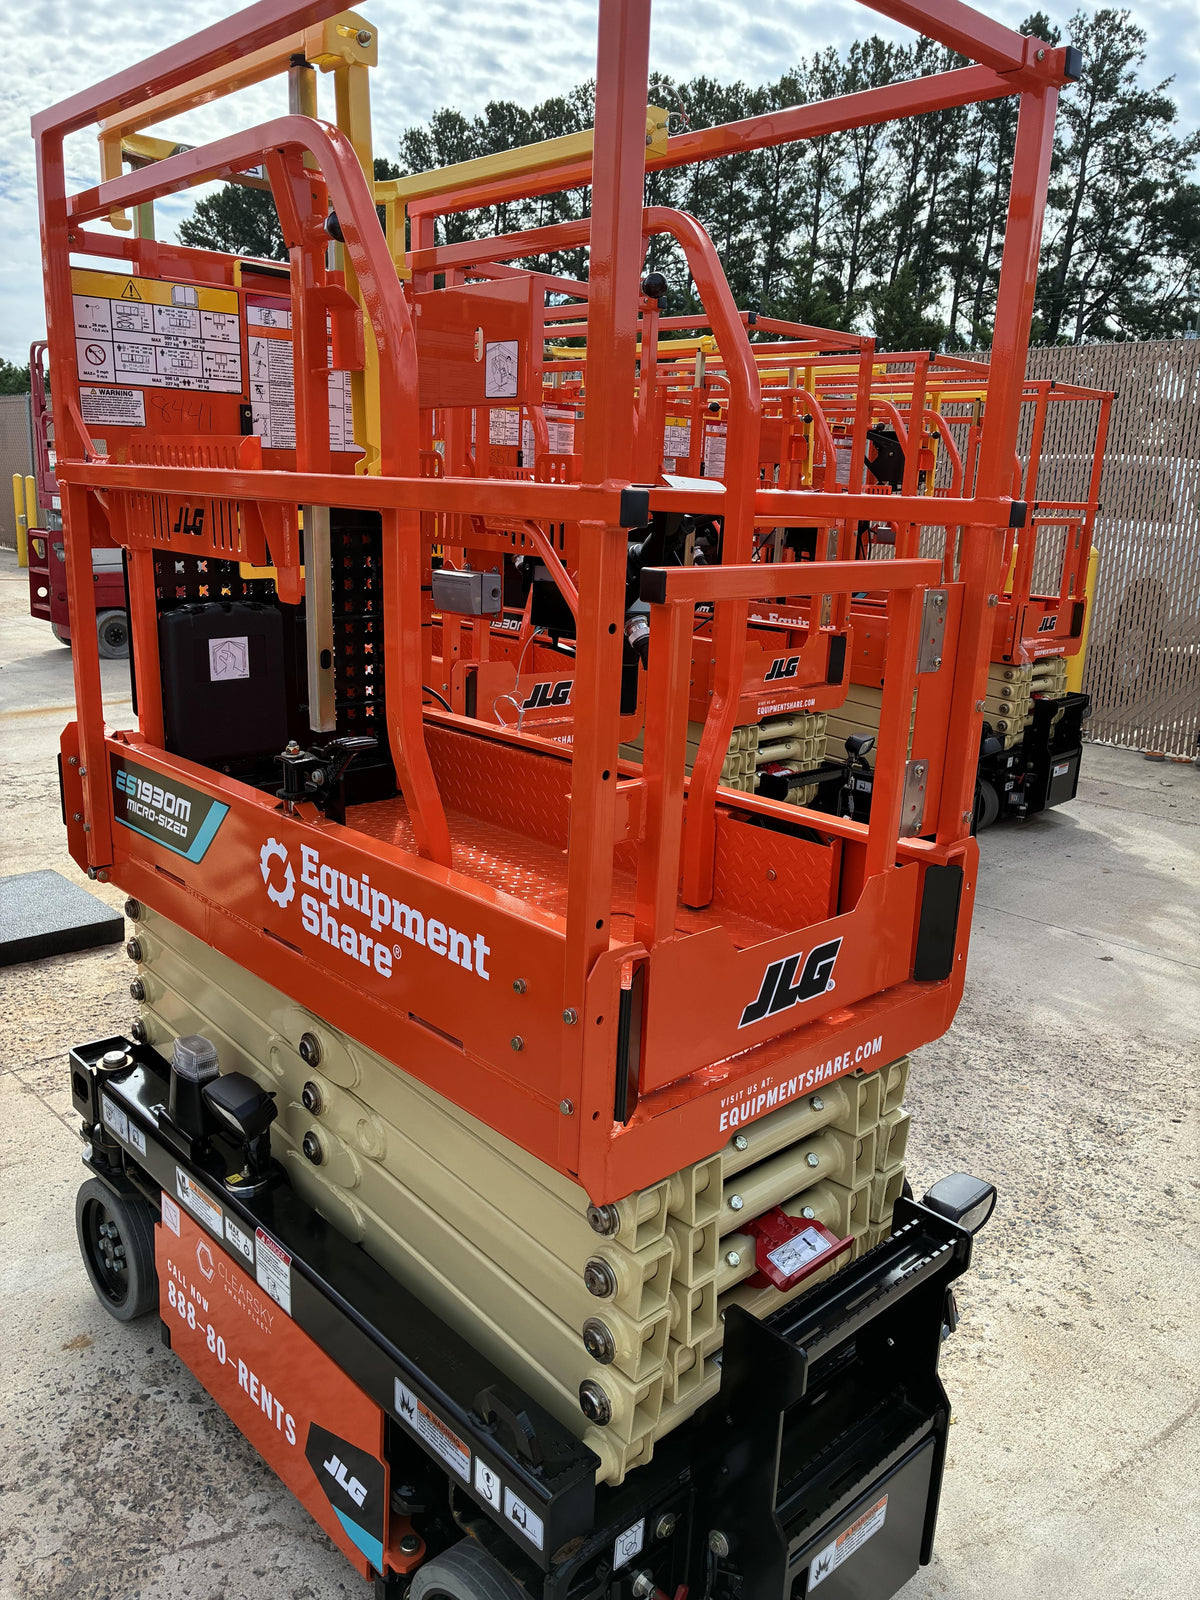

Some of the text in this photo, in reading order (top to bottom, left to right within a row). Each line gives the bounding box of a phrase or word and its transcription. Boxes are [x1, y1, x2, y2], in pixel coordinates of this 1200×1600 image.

[98, 388, 134, 397] WARNING
[151, 395, 212, 433] 8441
[173, 506, 205, 537] JLG
[1037, 615, 1058, 633] JLG
[763, 655, 801, 682] JLG
[522, 680, 574, 709] JLG
[757, 698, 816, 715] EQUIPMENTSHARE.COM
[115, 769, 192, 823] ES1930M
[126, 798, 188, 838] MICRO-SIZED
[300, 843, 491, 981] Equipment
[719, 1035, 883, 1132] EQUIPMENTSHARE.COM
[720, 1076, 774, 1108] VISIT US AT:
[265, 1236, 286, 1261] DANGER
[167, 1259, 209, 1313] CALL NOW
[217, 1261, 274, 1328] CLEARSKY
[224, 1284, 246, 1310] SMART
[168, 1280, 296, 1446] 888-80-RENTS
[322, 1454, 368, 1508] JLG
